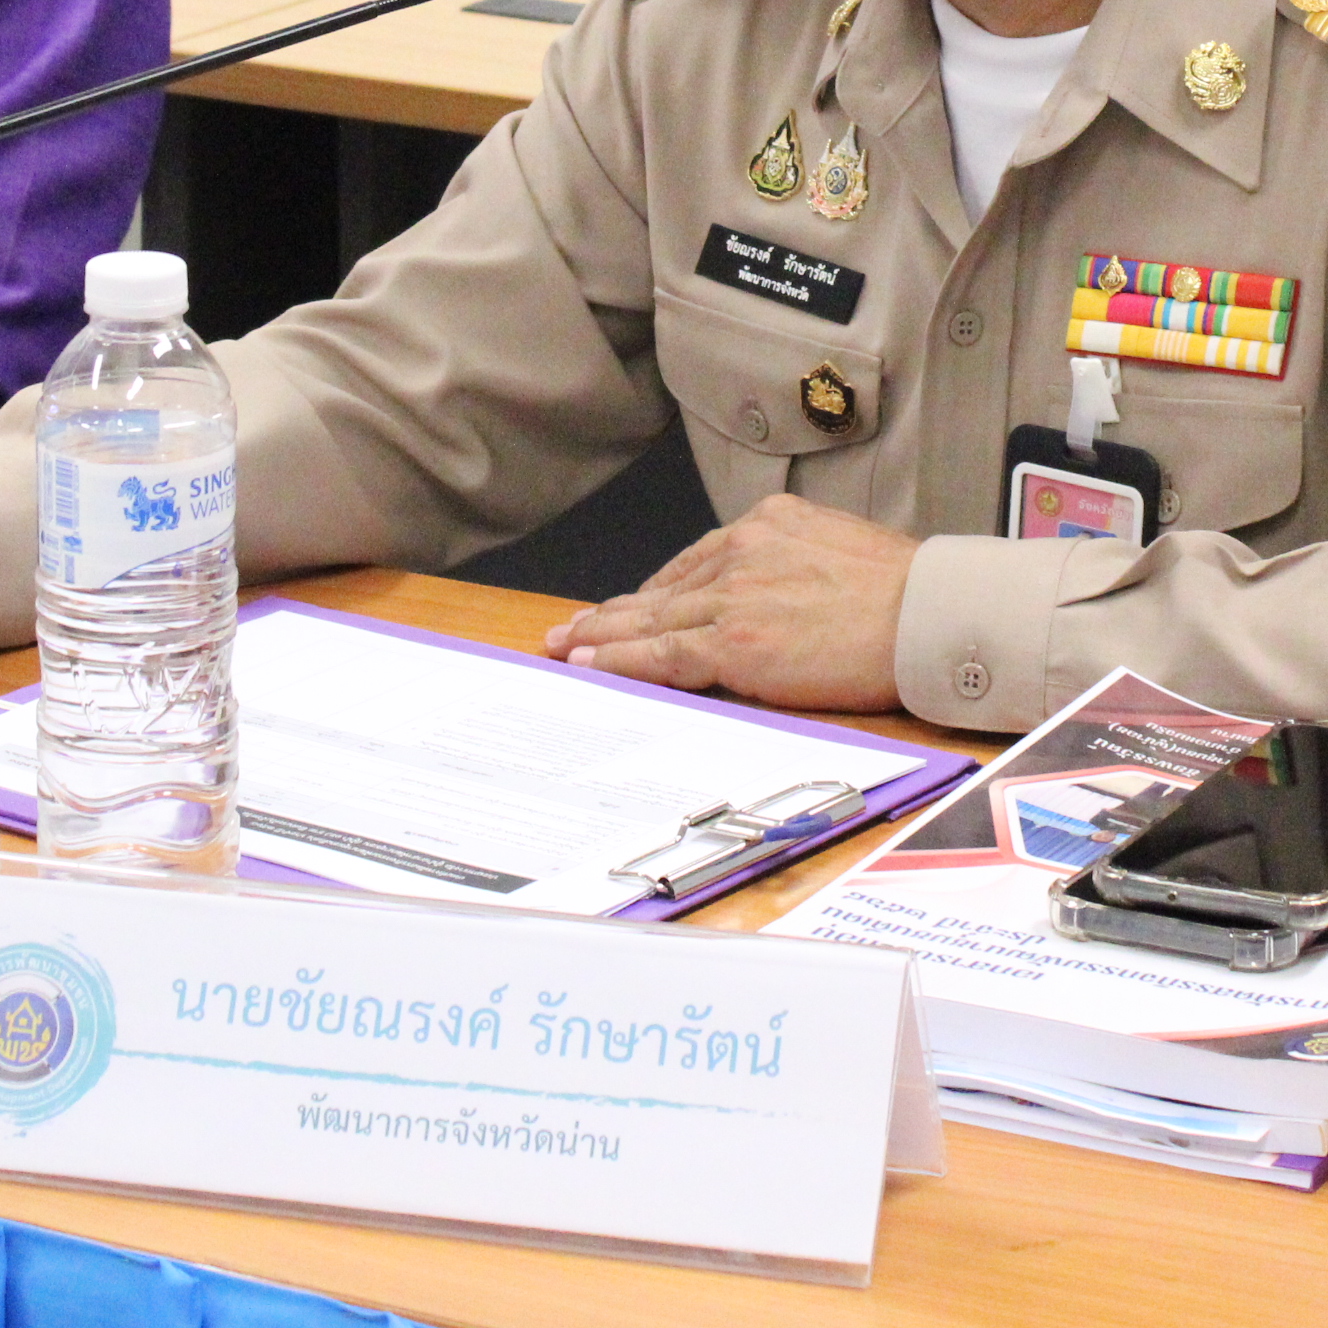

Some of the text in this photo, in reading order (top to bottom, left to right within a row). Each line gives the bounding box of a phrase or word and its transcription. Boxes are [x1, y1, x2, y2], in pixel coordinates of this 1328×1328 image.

[726, 234, 840, 286] ชัยณรงค์ รักษารัตน์
[738, 265, 810, 302] พัฒนาการจังหวัด
[171, 967, 790, 1078] นายชัยณรงค์ รักษารัตน์
[296, 1092, 622, 1162] พัฒนาการจังหวัดน่าน
